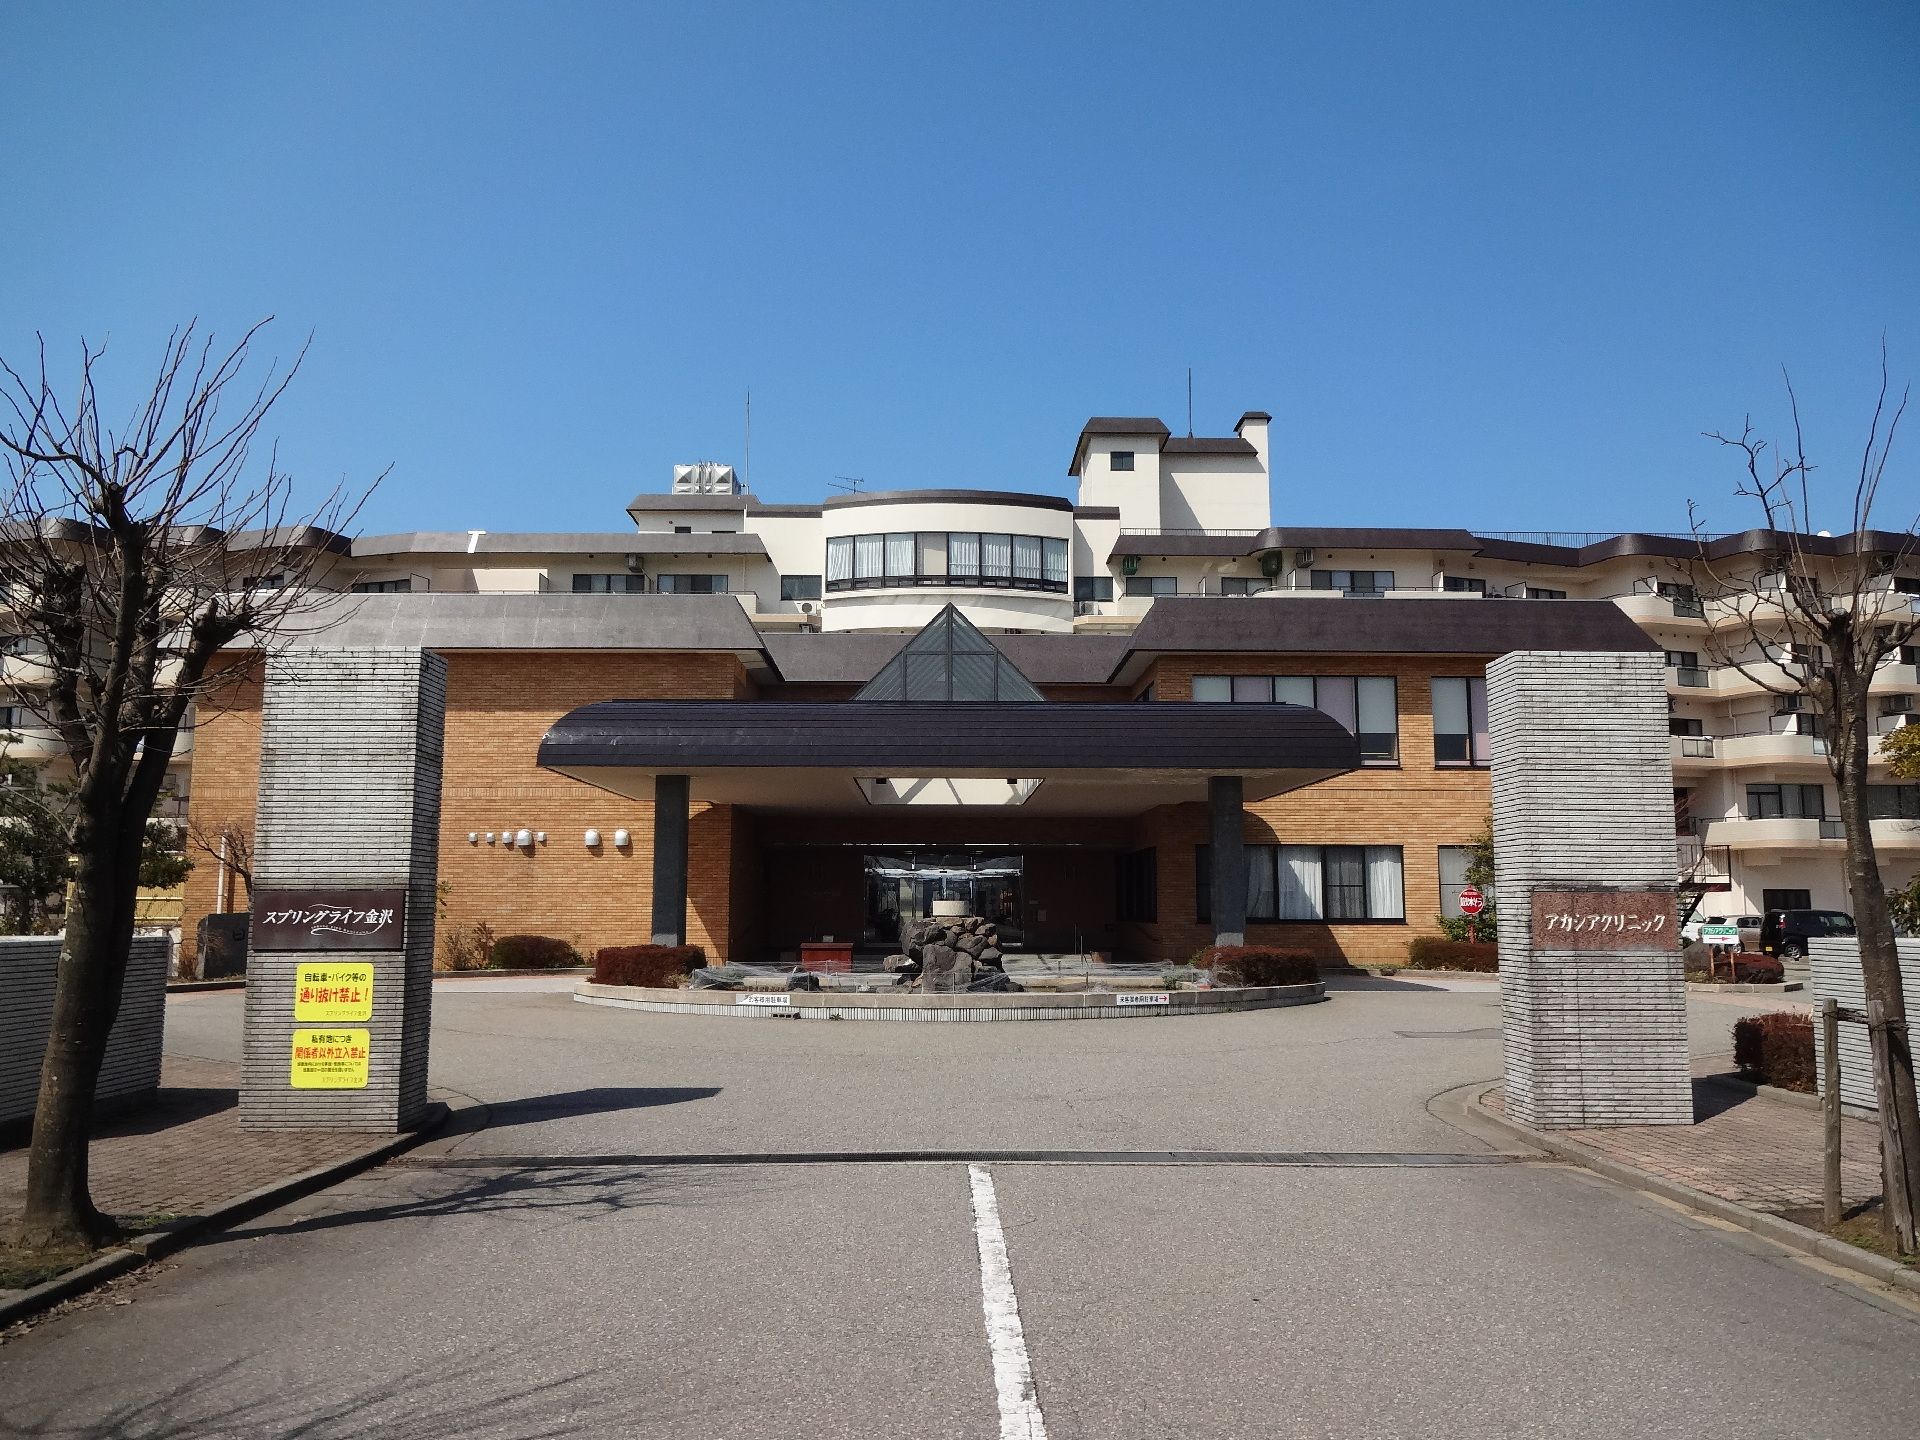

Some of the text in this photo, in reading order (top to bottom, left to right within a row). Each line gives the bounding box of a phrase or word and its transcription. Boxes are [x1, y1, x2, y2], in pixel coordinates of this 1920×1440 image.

[262, 909, 393, 925] スプリングライフ金沢
[1545, 913, 1666, 932] アカシアクリニック
[304, 972, 367, 983] 自転車・バイク等の
[311, 1034, 353, 1044] 私有地につき
[294, 1046, 366, 1060] 関係者以外立入禁止
